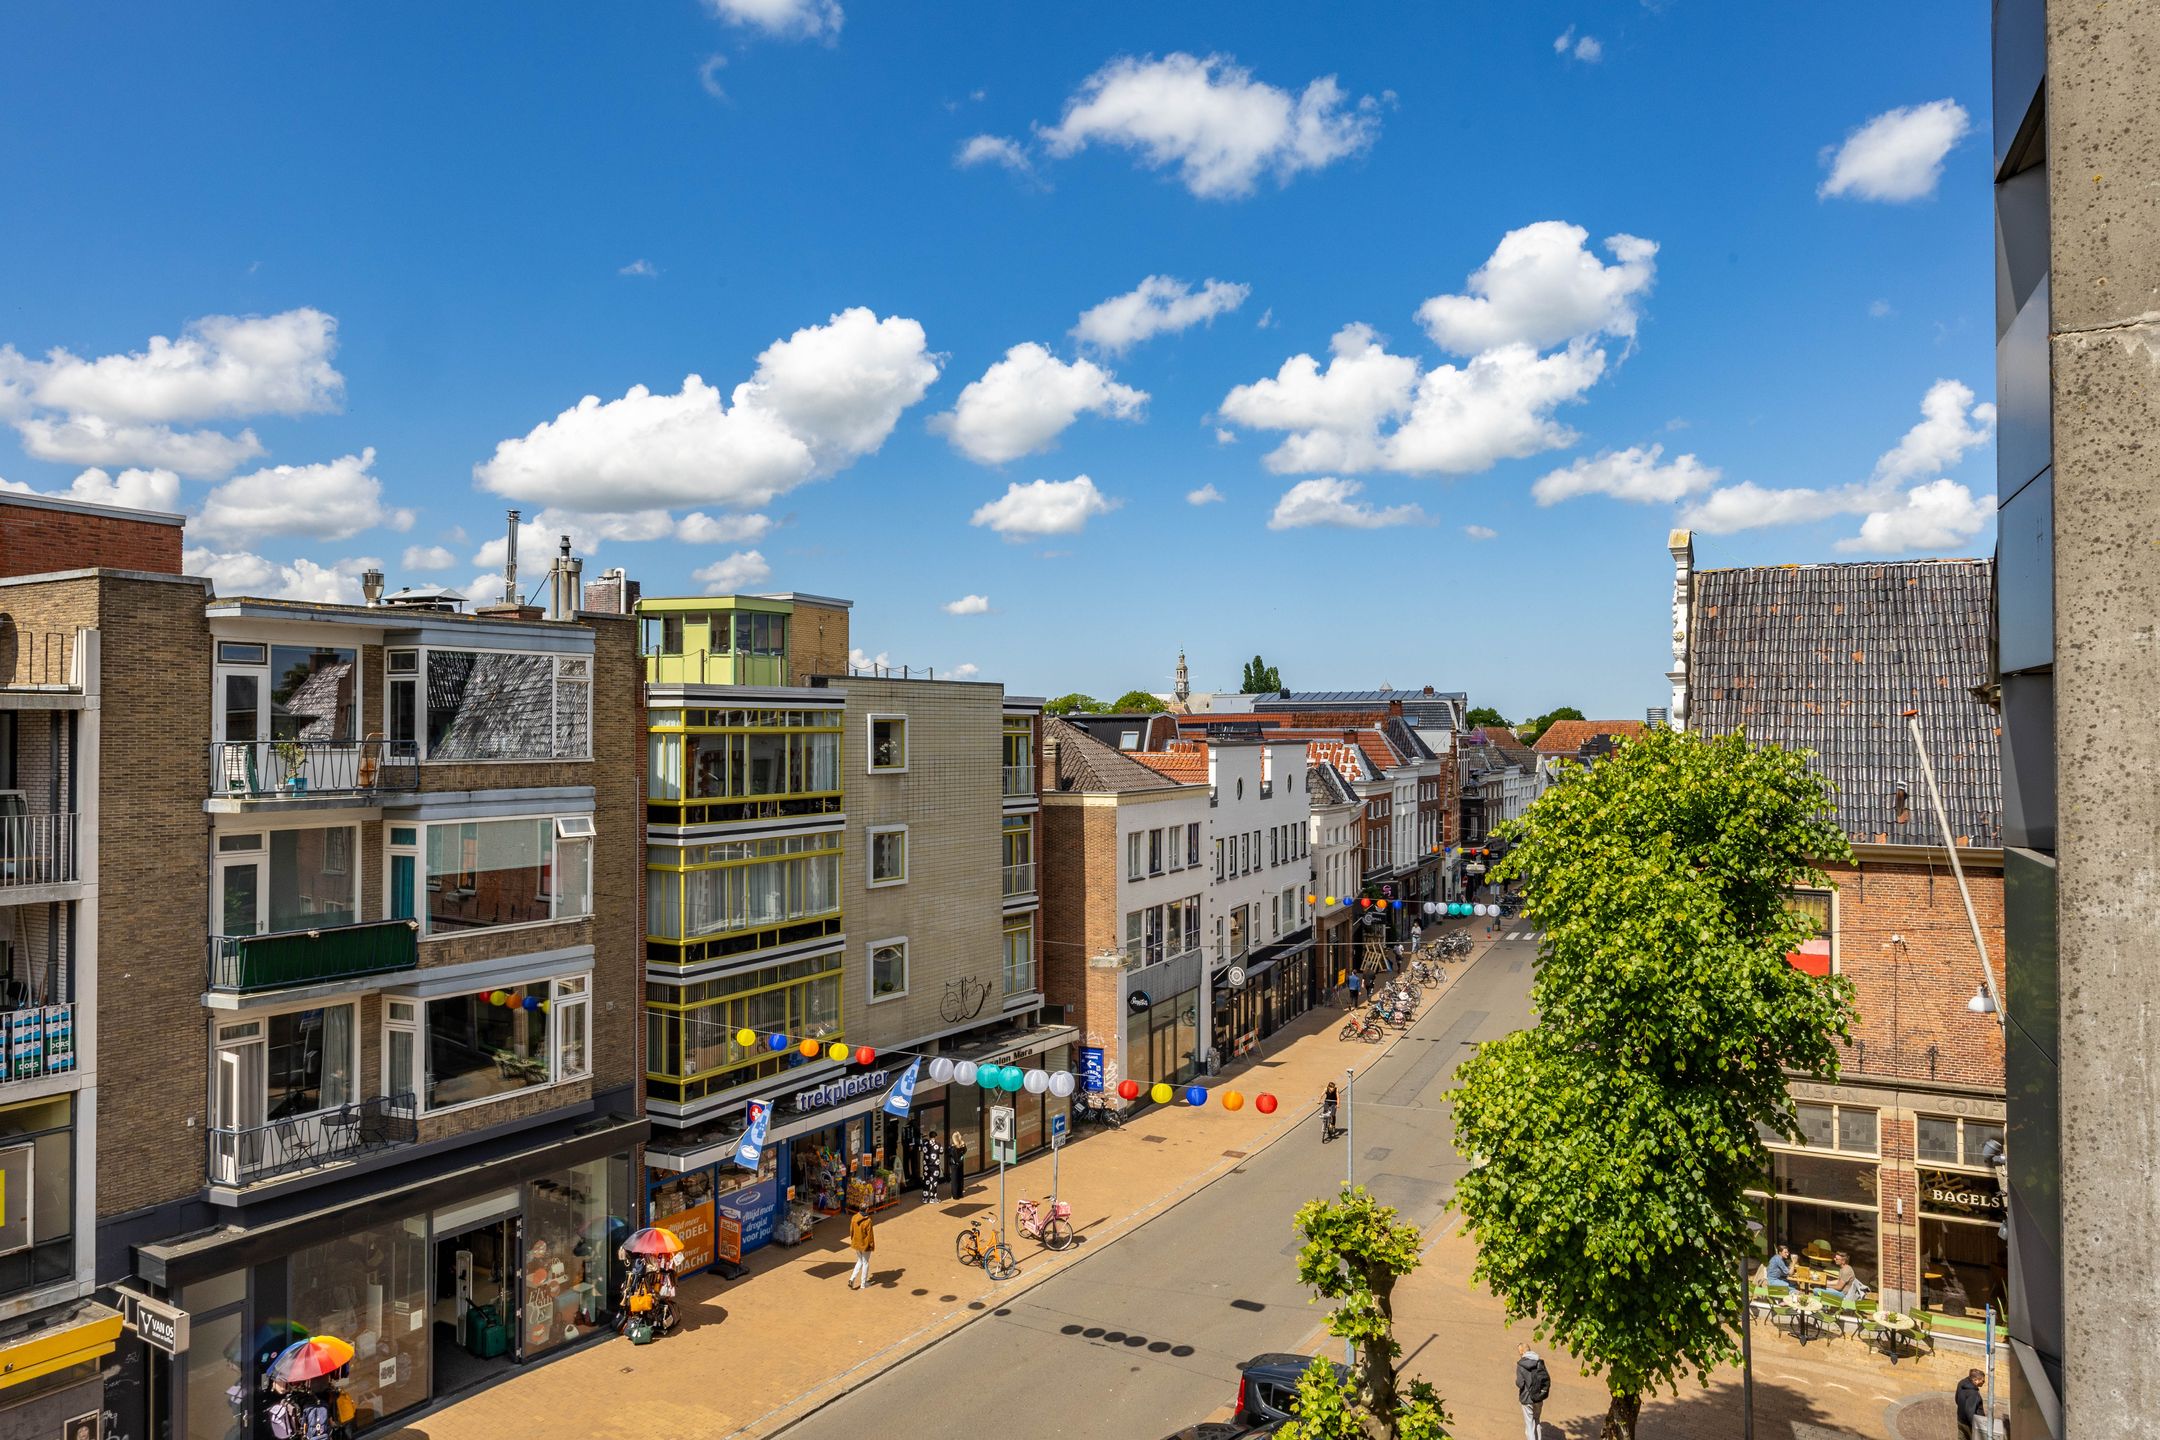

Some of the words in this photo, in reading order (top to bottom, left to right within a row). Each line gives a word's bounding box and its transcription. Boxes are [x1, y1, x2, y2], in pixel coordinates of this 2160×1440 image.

[1014, 1048, 1033, 1060] Mara
[799, 1070, 889, 1111] trekpleister
[1797, 1083, 1859, 1103] NSEN
[1932, 1189, 2000, 1209] BAGELS
[679, 1222, 709, 1241] RDEEL
[742, 1231, 759, 1244] voor
[760, 1225, 773, 1240] jou!
[676, 1251, 710, 1274] DACHT
[152, 1318, 165, 1335] VAN
[165, 1325, 174, 1338] OS
